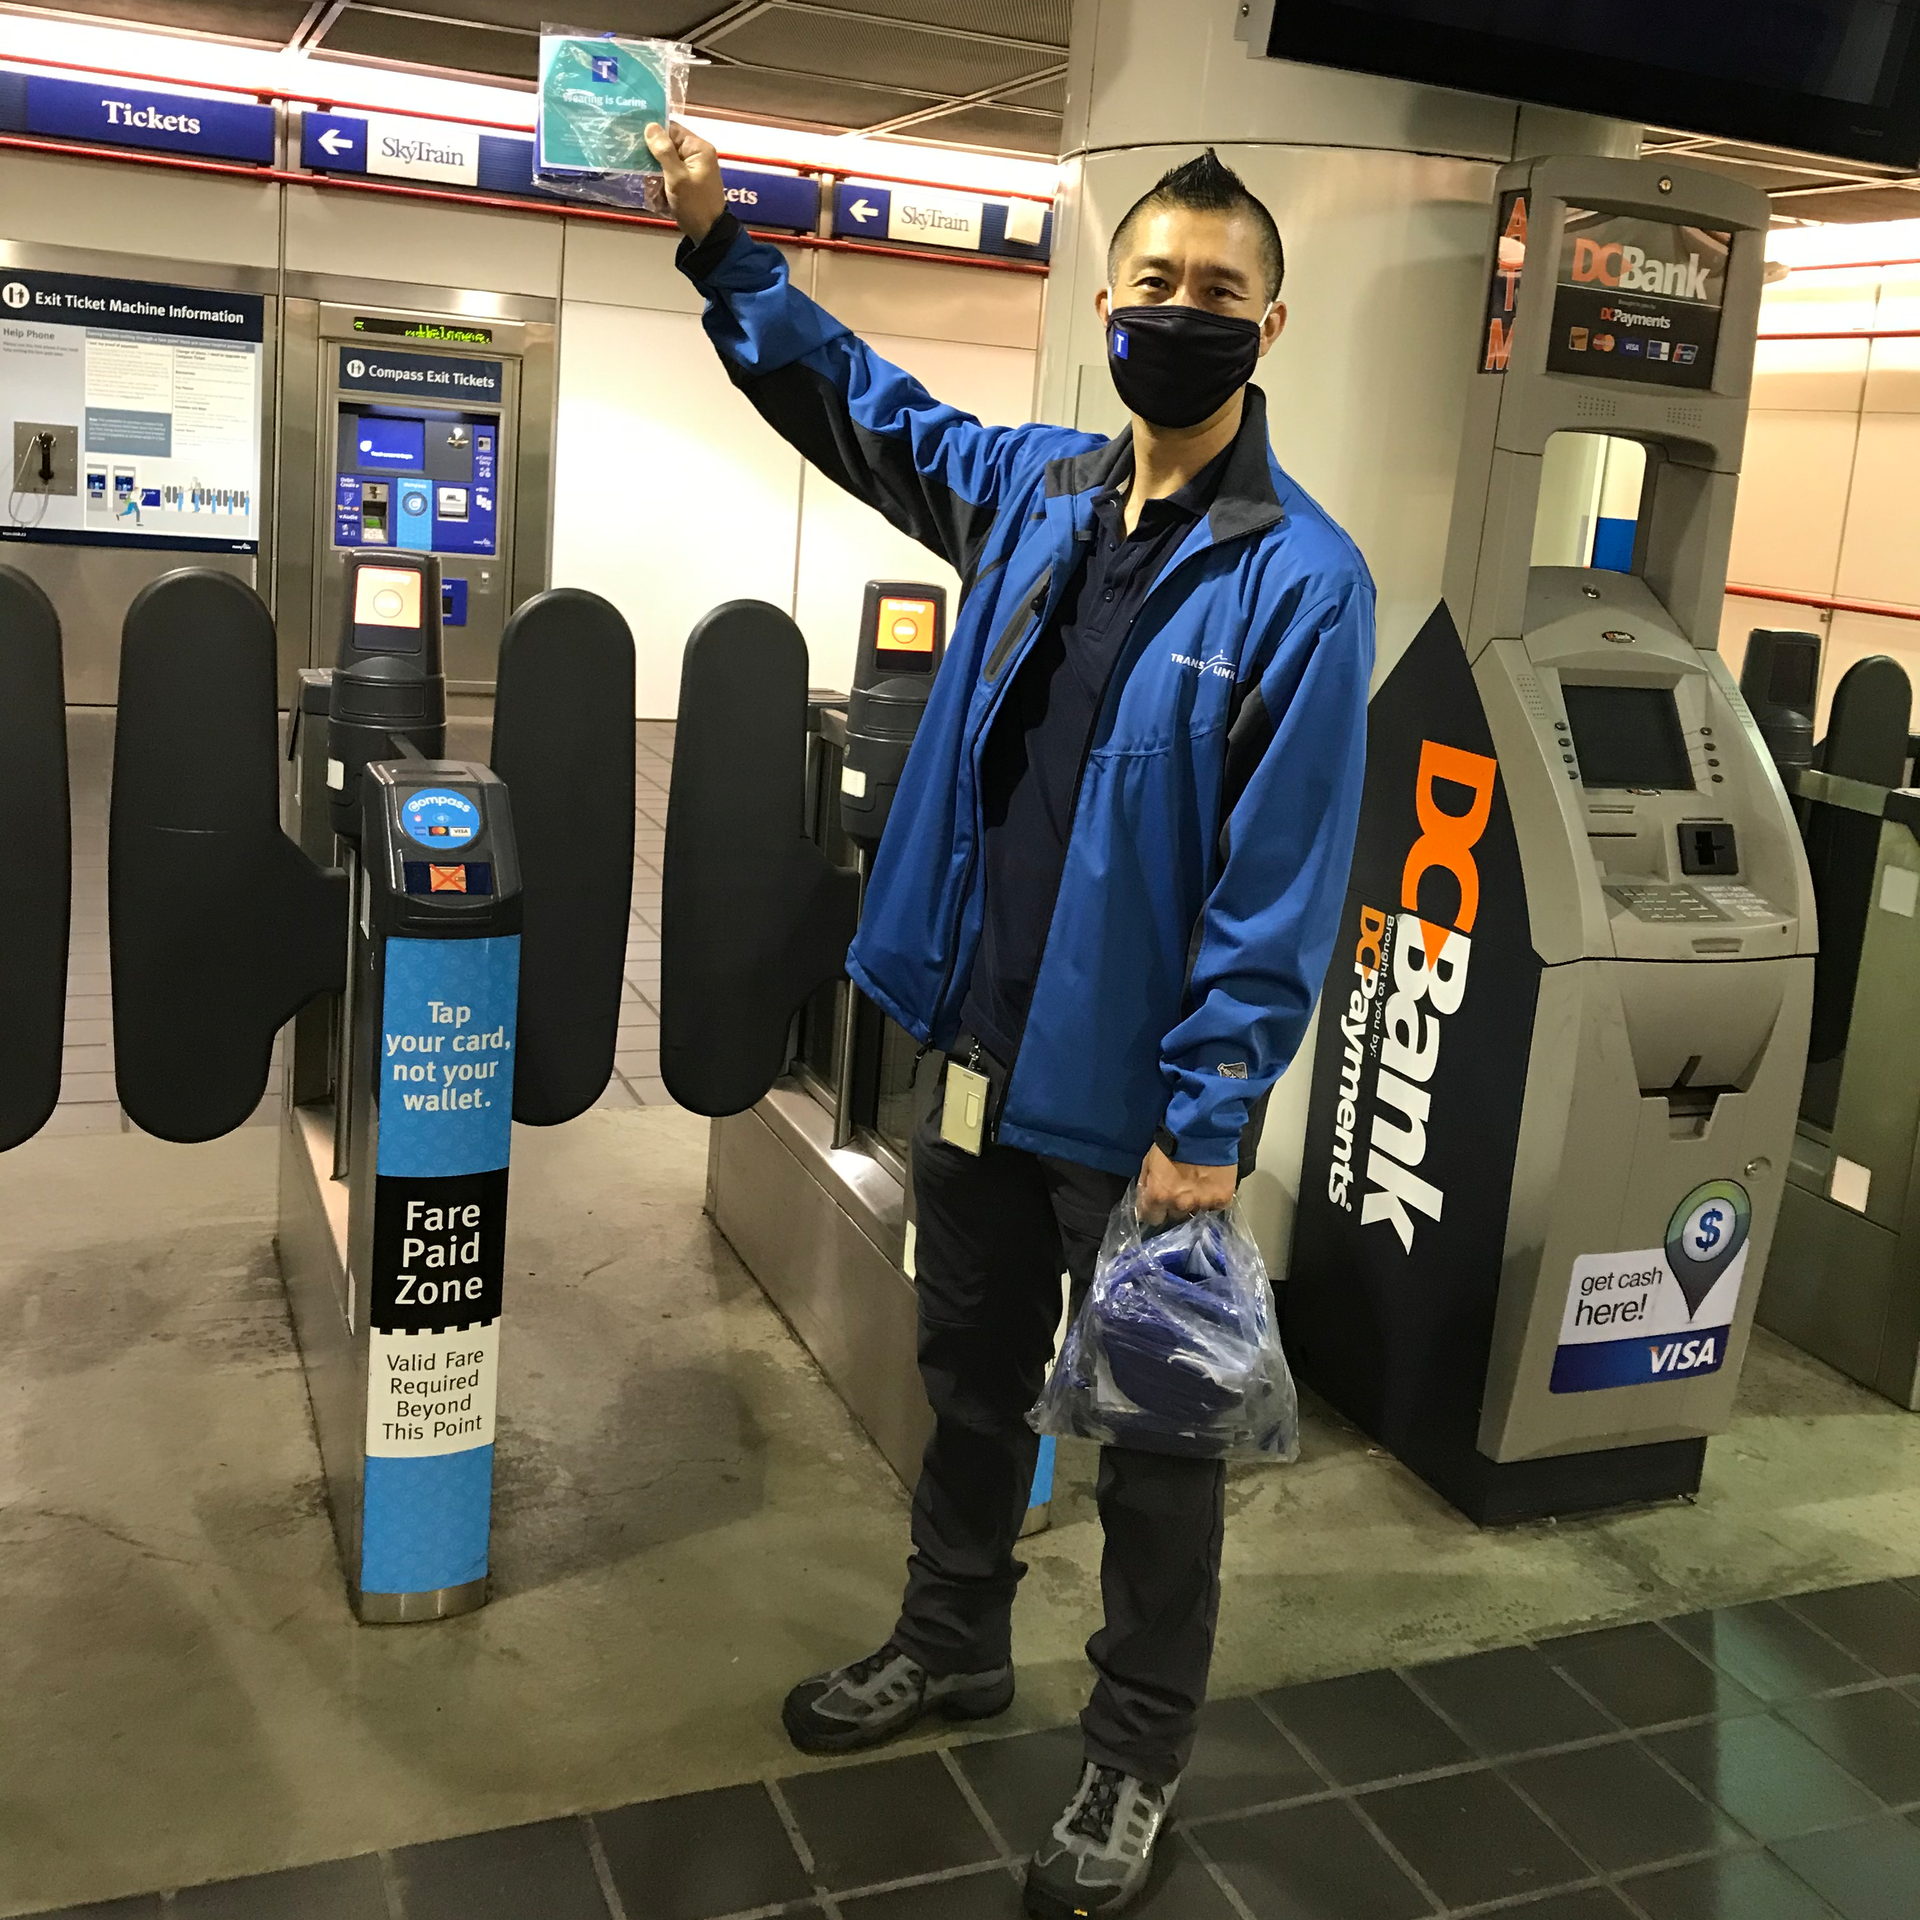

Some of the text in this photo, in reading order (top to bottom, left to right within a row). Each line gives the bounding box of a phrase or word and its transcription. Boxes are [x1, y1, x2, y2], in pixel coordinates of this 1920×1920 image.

[598, 61, 613, 79] T
[563, 93, 648, 109] Wearing is Caring
[102, 100, 201, 135] Tickets
[381, 137, 465, 167] SkyTrain
[901, 206, 970, 232] SkyTrain
[1571, 238, 1711, 300] DCBank
[35, 291, 244, 324] Exit Ticket Machine Information
[1600, 307, 1671, 329] DCPayments
[3, 328, 55, 340] Help Phone
[1116, 334, 1125, 353] T
[1625, 343, 1640, 352] VISA
[368, 365, 495, 388] Compass Exit Tickets
[1361, 739, 1498, 1256] DCBank
[1370, 914, 1395, 1058] Brought to you by:
[427, 1002, 471, 1027] Tap
[386, 1026, 511, 1056] your card,
[1328, 904, 1385, 1208] DCPayments
[394, 1058, 499, 1088] not your
[403, 1087, 492, 1112] wallet.
[406, 1200, 481, 1231] Fare
[402, 1232, 480, 1268] Paid
[395, 1274, 484, 1305] Zone
[1581, 1266, 1663, 1296] get cash
[1575, 1293, 1648, 1326] here!
[387, 1349, 485, 1371] Valid Fare
[1649, 1338, 1714, 1373] VISA
[390, 1369, 479, 1398] Required
[396, 1396, 472, 1423] Beyond
[382, 1414, 483, 1441] This Point
